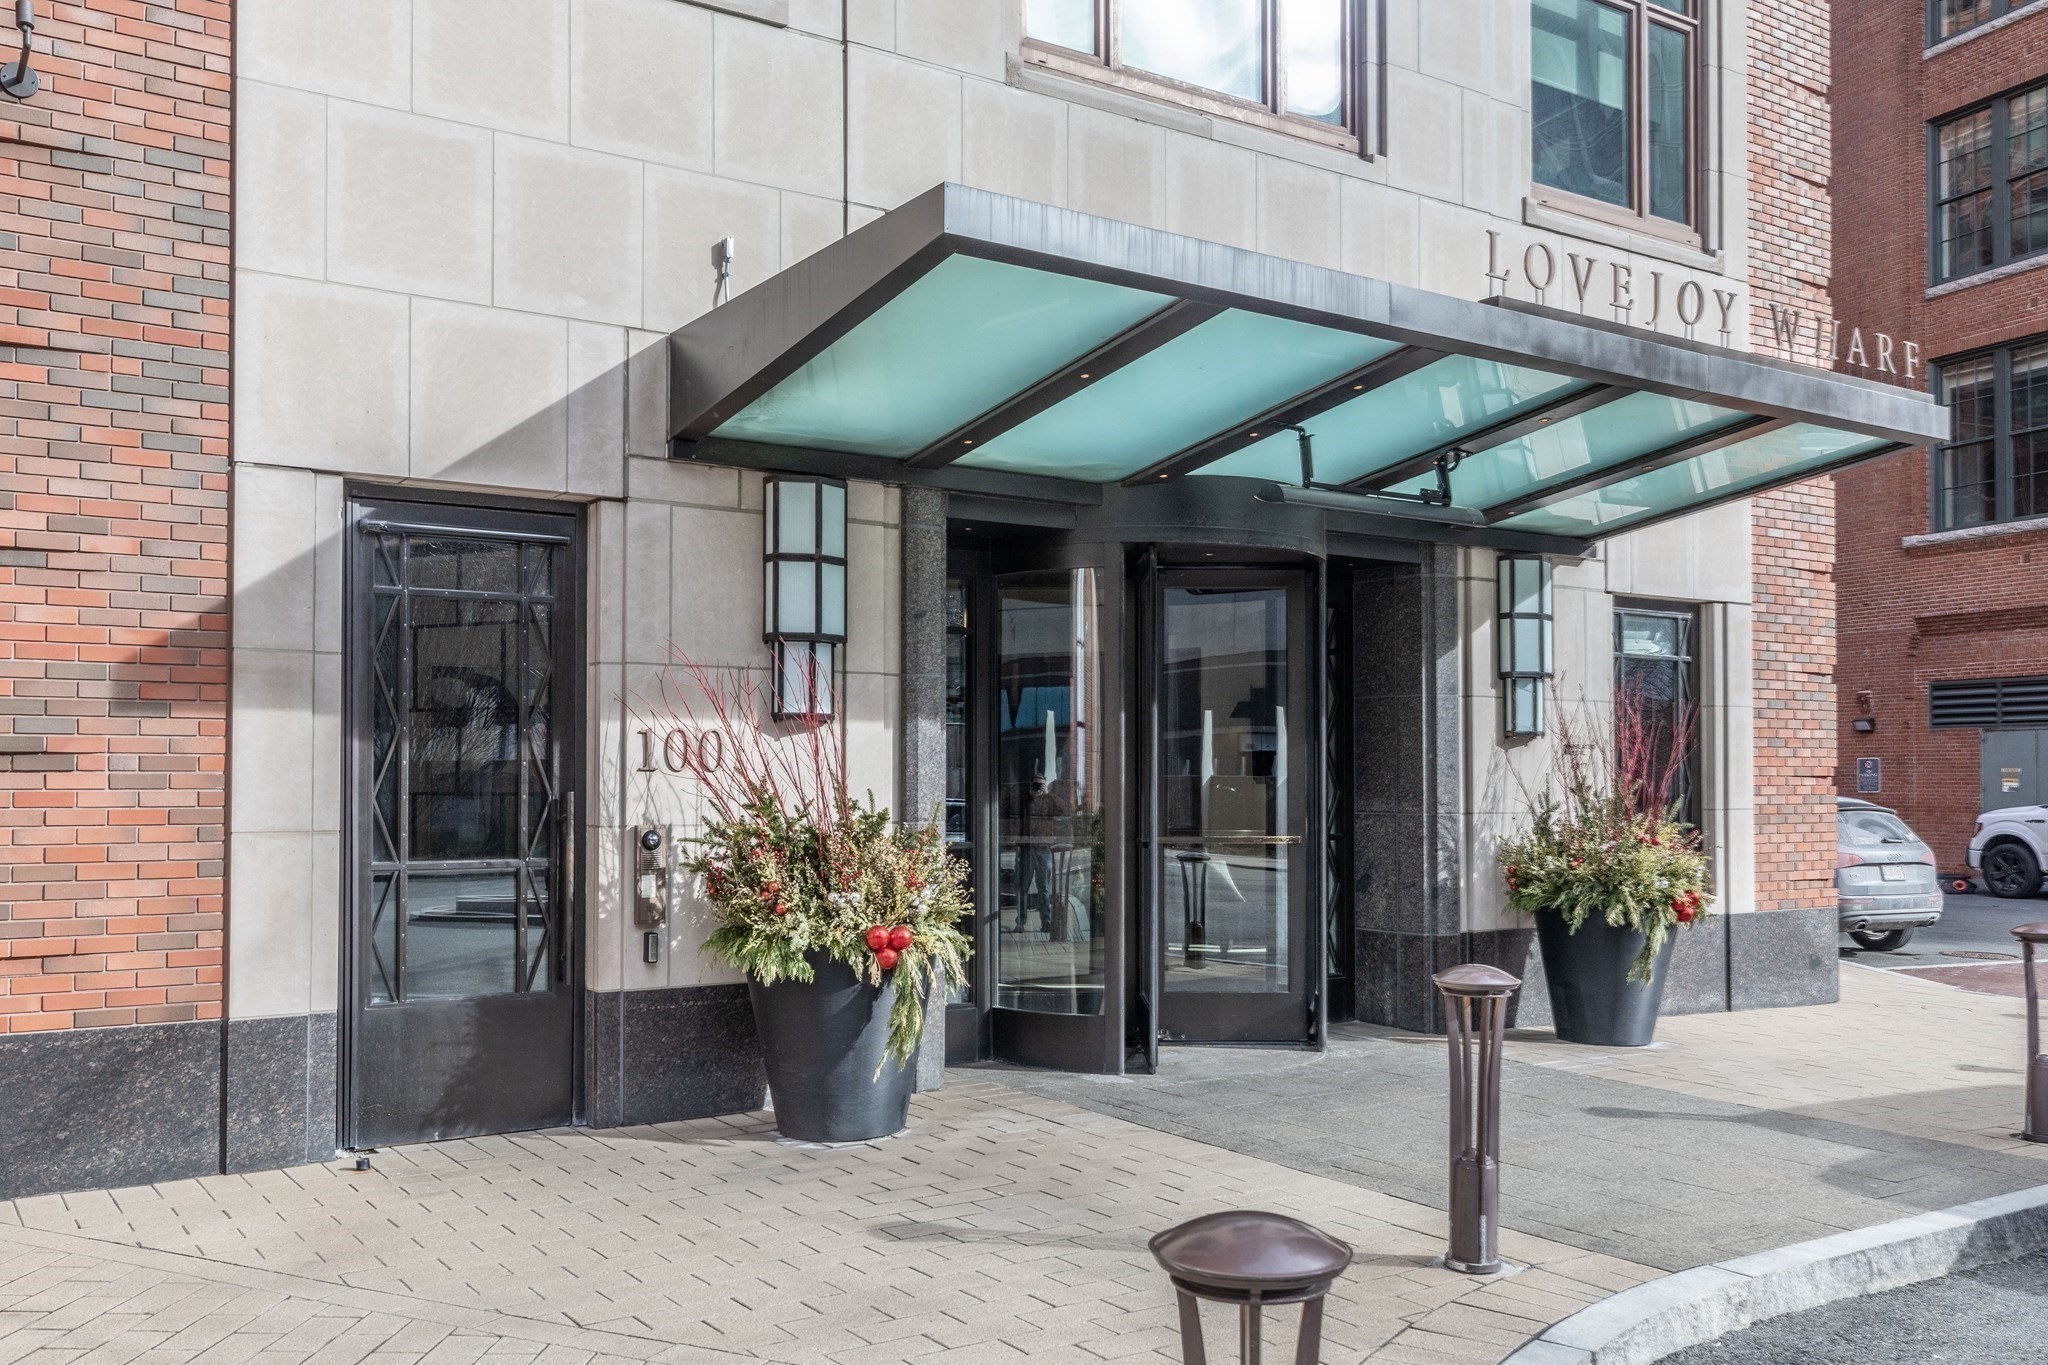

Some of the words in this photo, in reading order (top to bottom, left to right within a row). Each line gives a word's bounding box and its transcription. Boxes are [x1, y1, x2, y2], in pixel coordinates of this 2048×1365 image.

[1484, 229, 1738, 334] LOVEJOY
[1768, 303, 1920, 379] WHARF
[636, 727, 723, 773] 100
